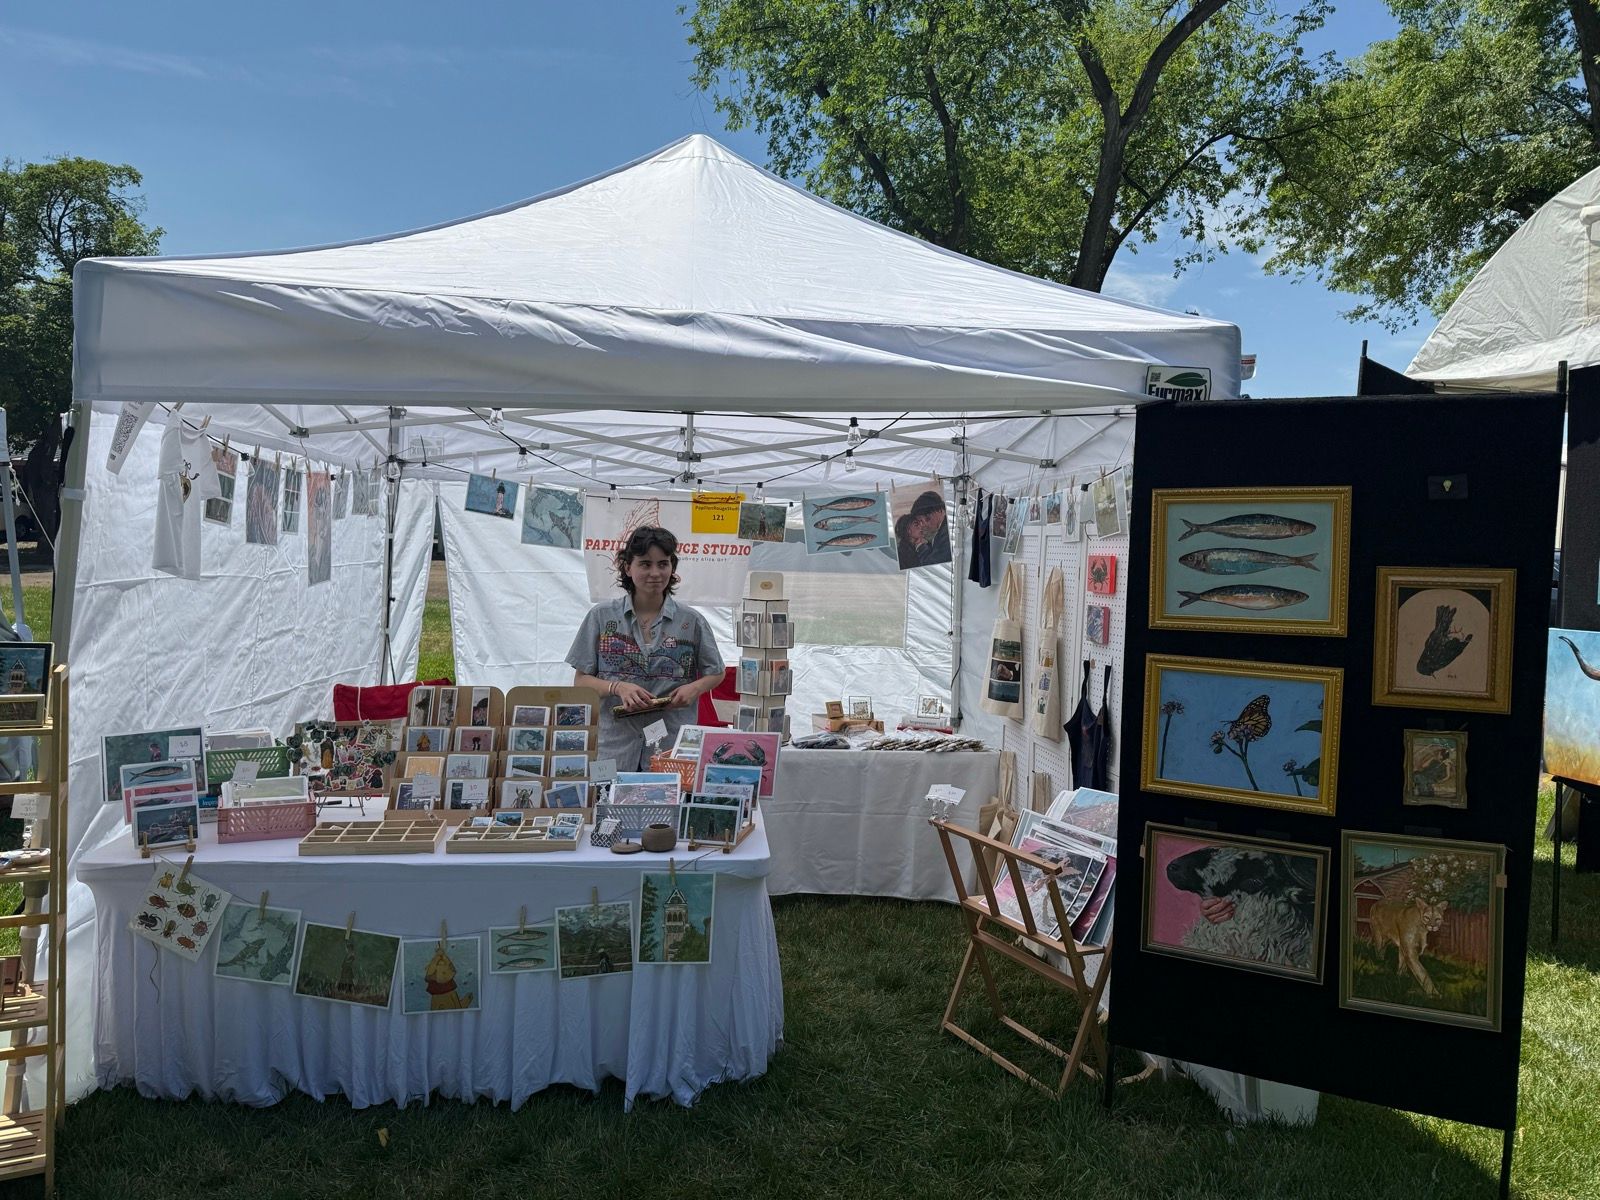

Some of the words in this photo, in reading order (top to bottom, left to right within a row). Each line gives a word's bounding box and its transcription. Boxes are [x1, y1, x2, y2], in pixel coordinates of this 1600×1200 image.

[585, 538, 623, 551] PAPIL
[675, 542, 699, 554] UGE
[702, 543, 751, 556] STUDIO
